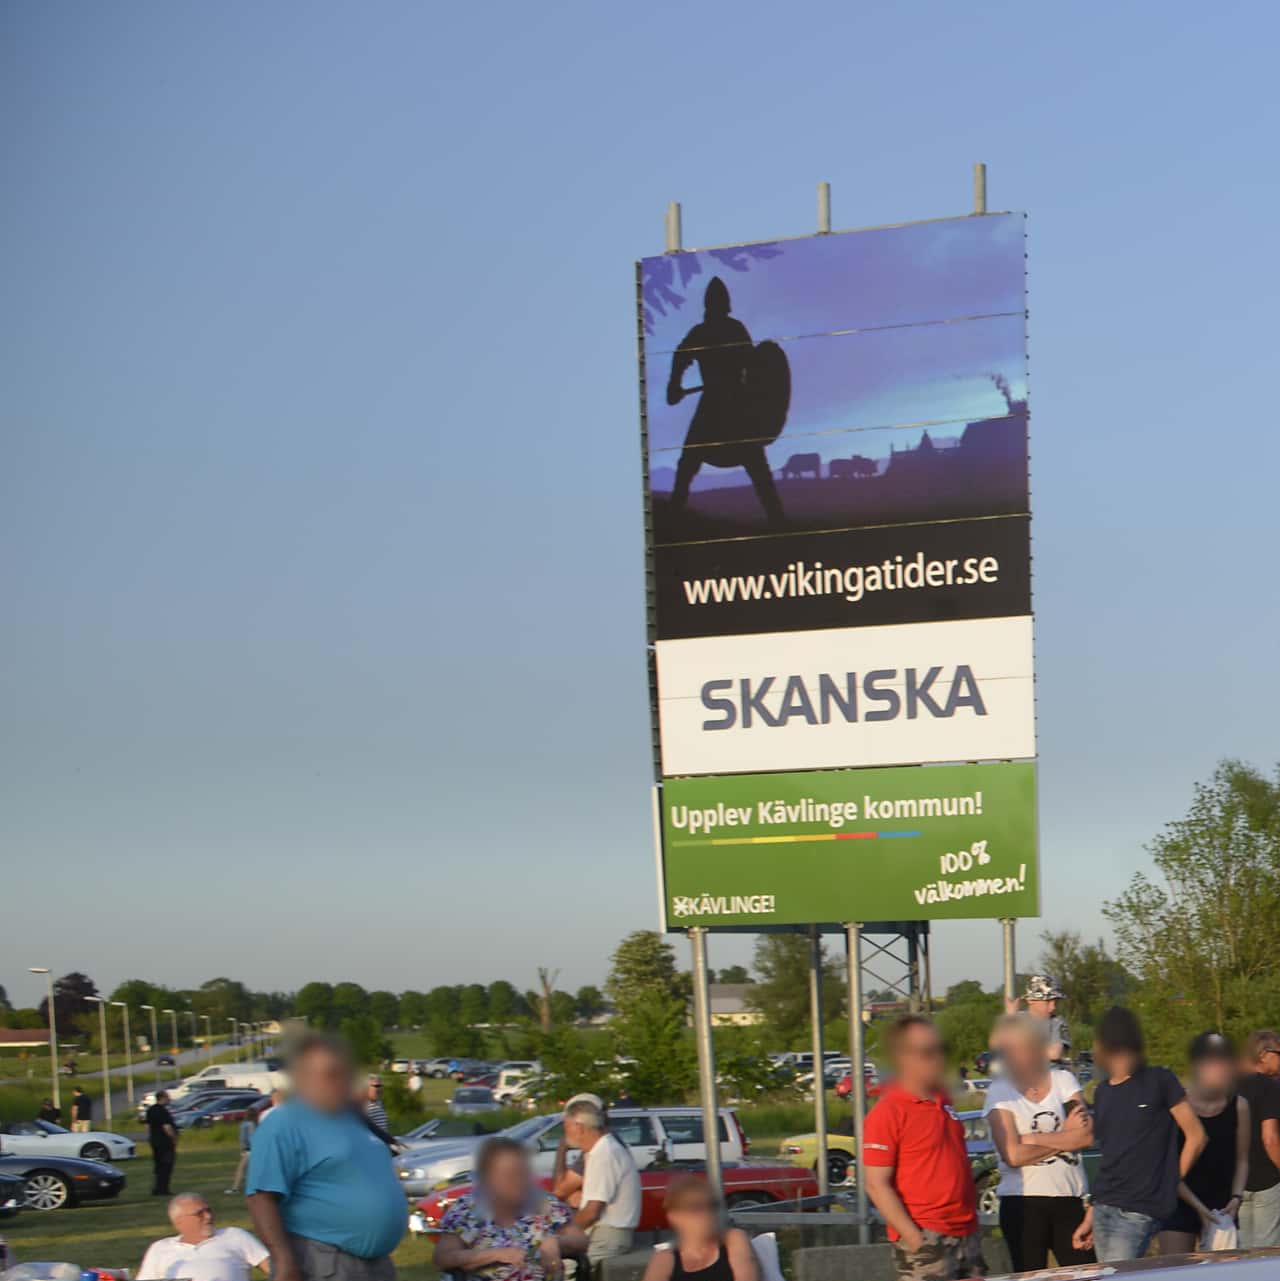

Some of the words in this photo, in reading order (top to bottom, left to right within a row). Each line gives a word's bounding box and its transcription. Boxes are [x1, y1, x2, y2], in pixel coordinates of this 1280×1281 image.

[683, 552, 999, 604] www.vikingatider.se
[700, 665, 989, 731] SKANSKA
[671, 803, 753, 834] Upplev
[758, 798, 858, 827] Kävlinge
[864, 791, 983, 820] kommun!
[940, 840, 991, 874] 100%
[914, 863, 1027, 904] välkommen!
